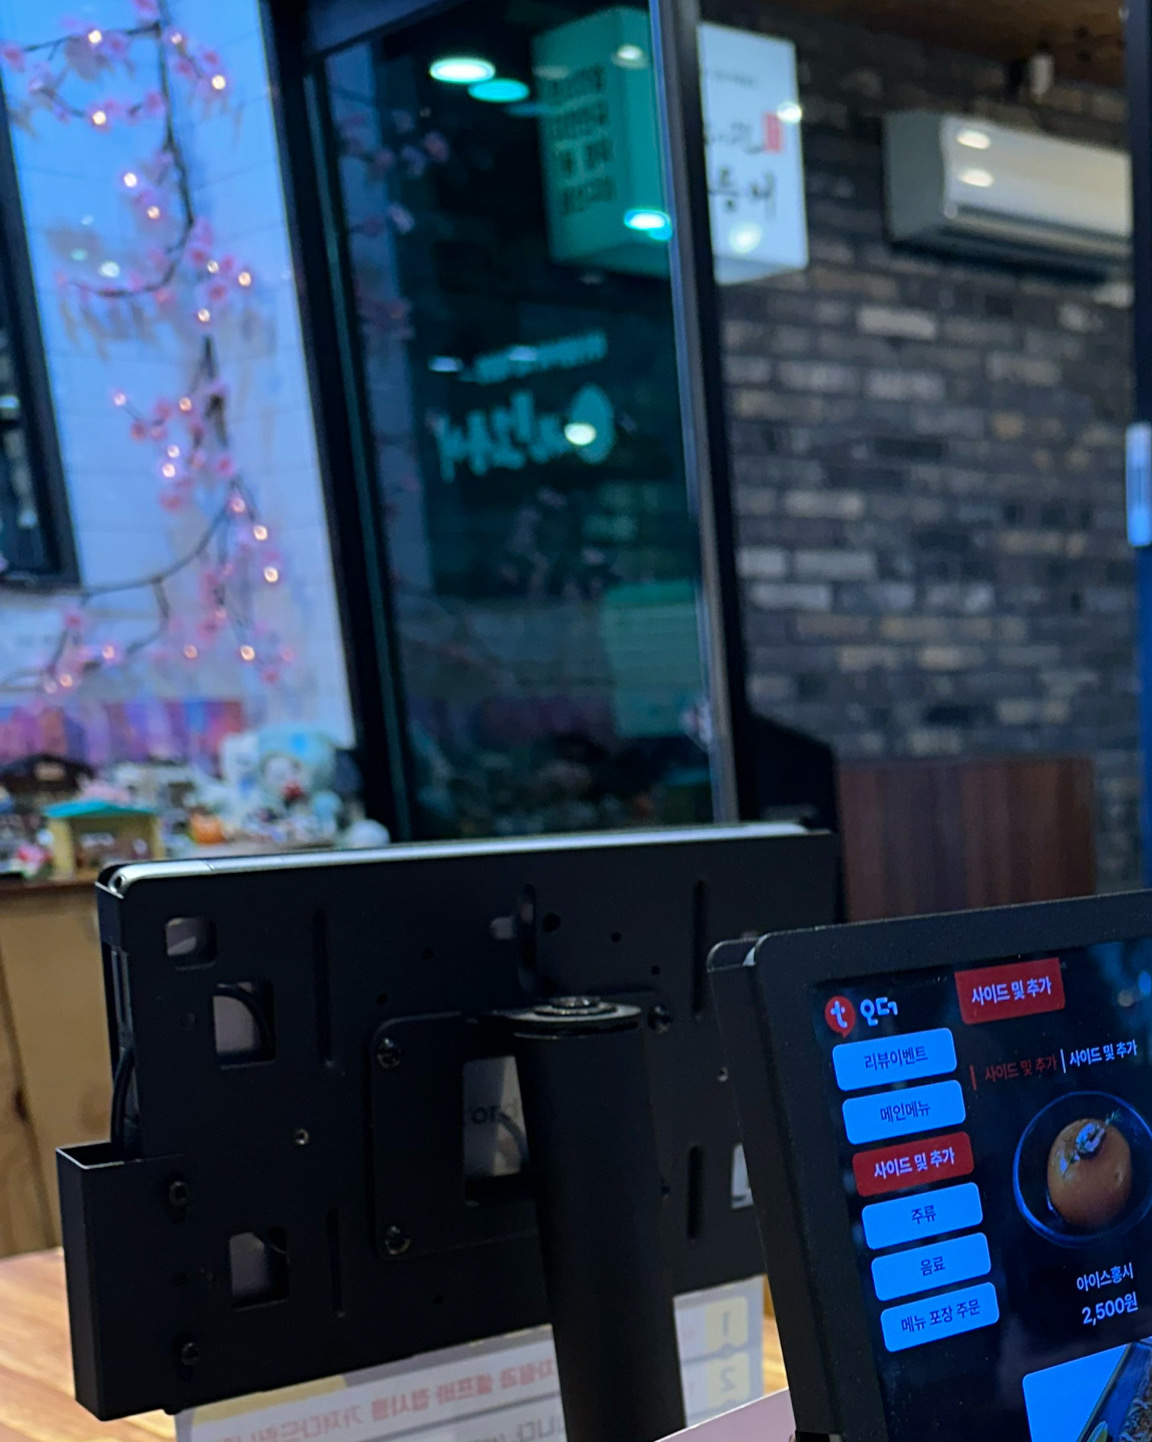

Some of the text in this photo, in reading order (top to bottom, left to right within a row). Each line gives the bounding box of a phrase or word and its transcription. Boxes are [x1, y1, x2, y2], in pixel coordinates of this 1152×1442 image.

[971, 975, 1052, 1007] 사이드 및 추가
[864, 1045, 928, 1071] 리뷰이벤트
[1069, 1039, 1137, 1067] 사이드 및 추가
[984, 1055, 1057, 1083] 사이드 및 추가
[880, 1102, 931, 1123] 메인메뉴
[874, 1146, 955, 1180] 사이드 및 추가
[911, 1204, 937, 1225] 주류
[920, 1256, 946, 1276] 음료
[1076, 1262, 1134, 1292] 아이스홍시
[901, 1299, 980, 1333] 메뉴 포장 주문
[1081, 1291, 1138, 1327] 2,500원
